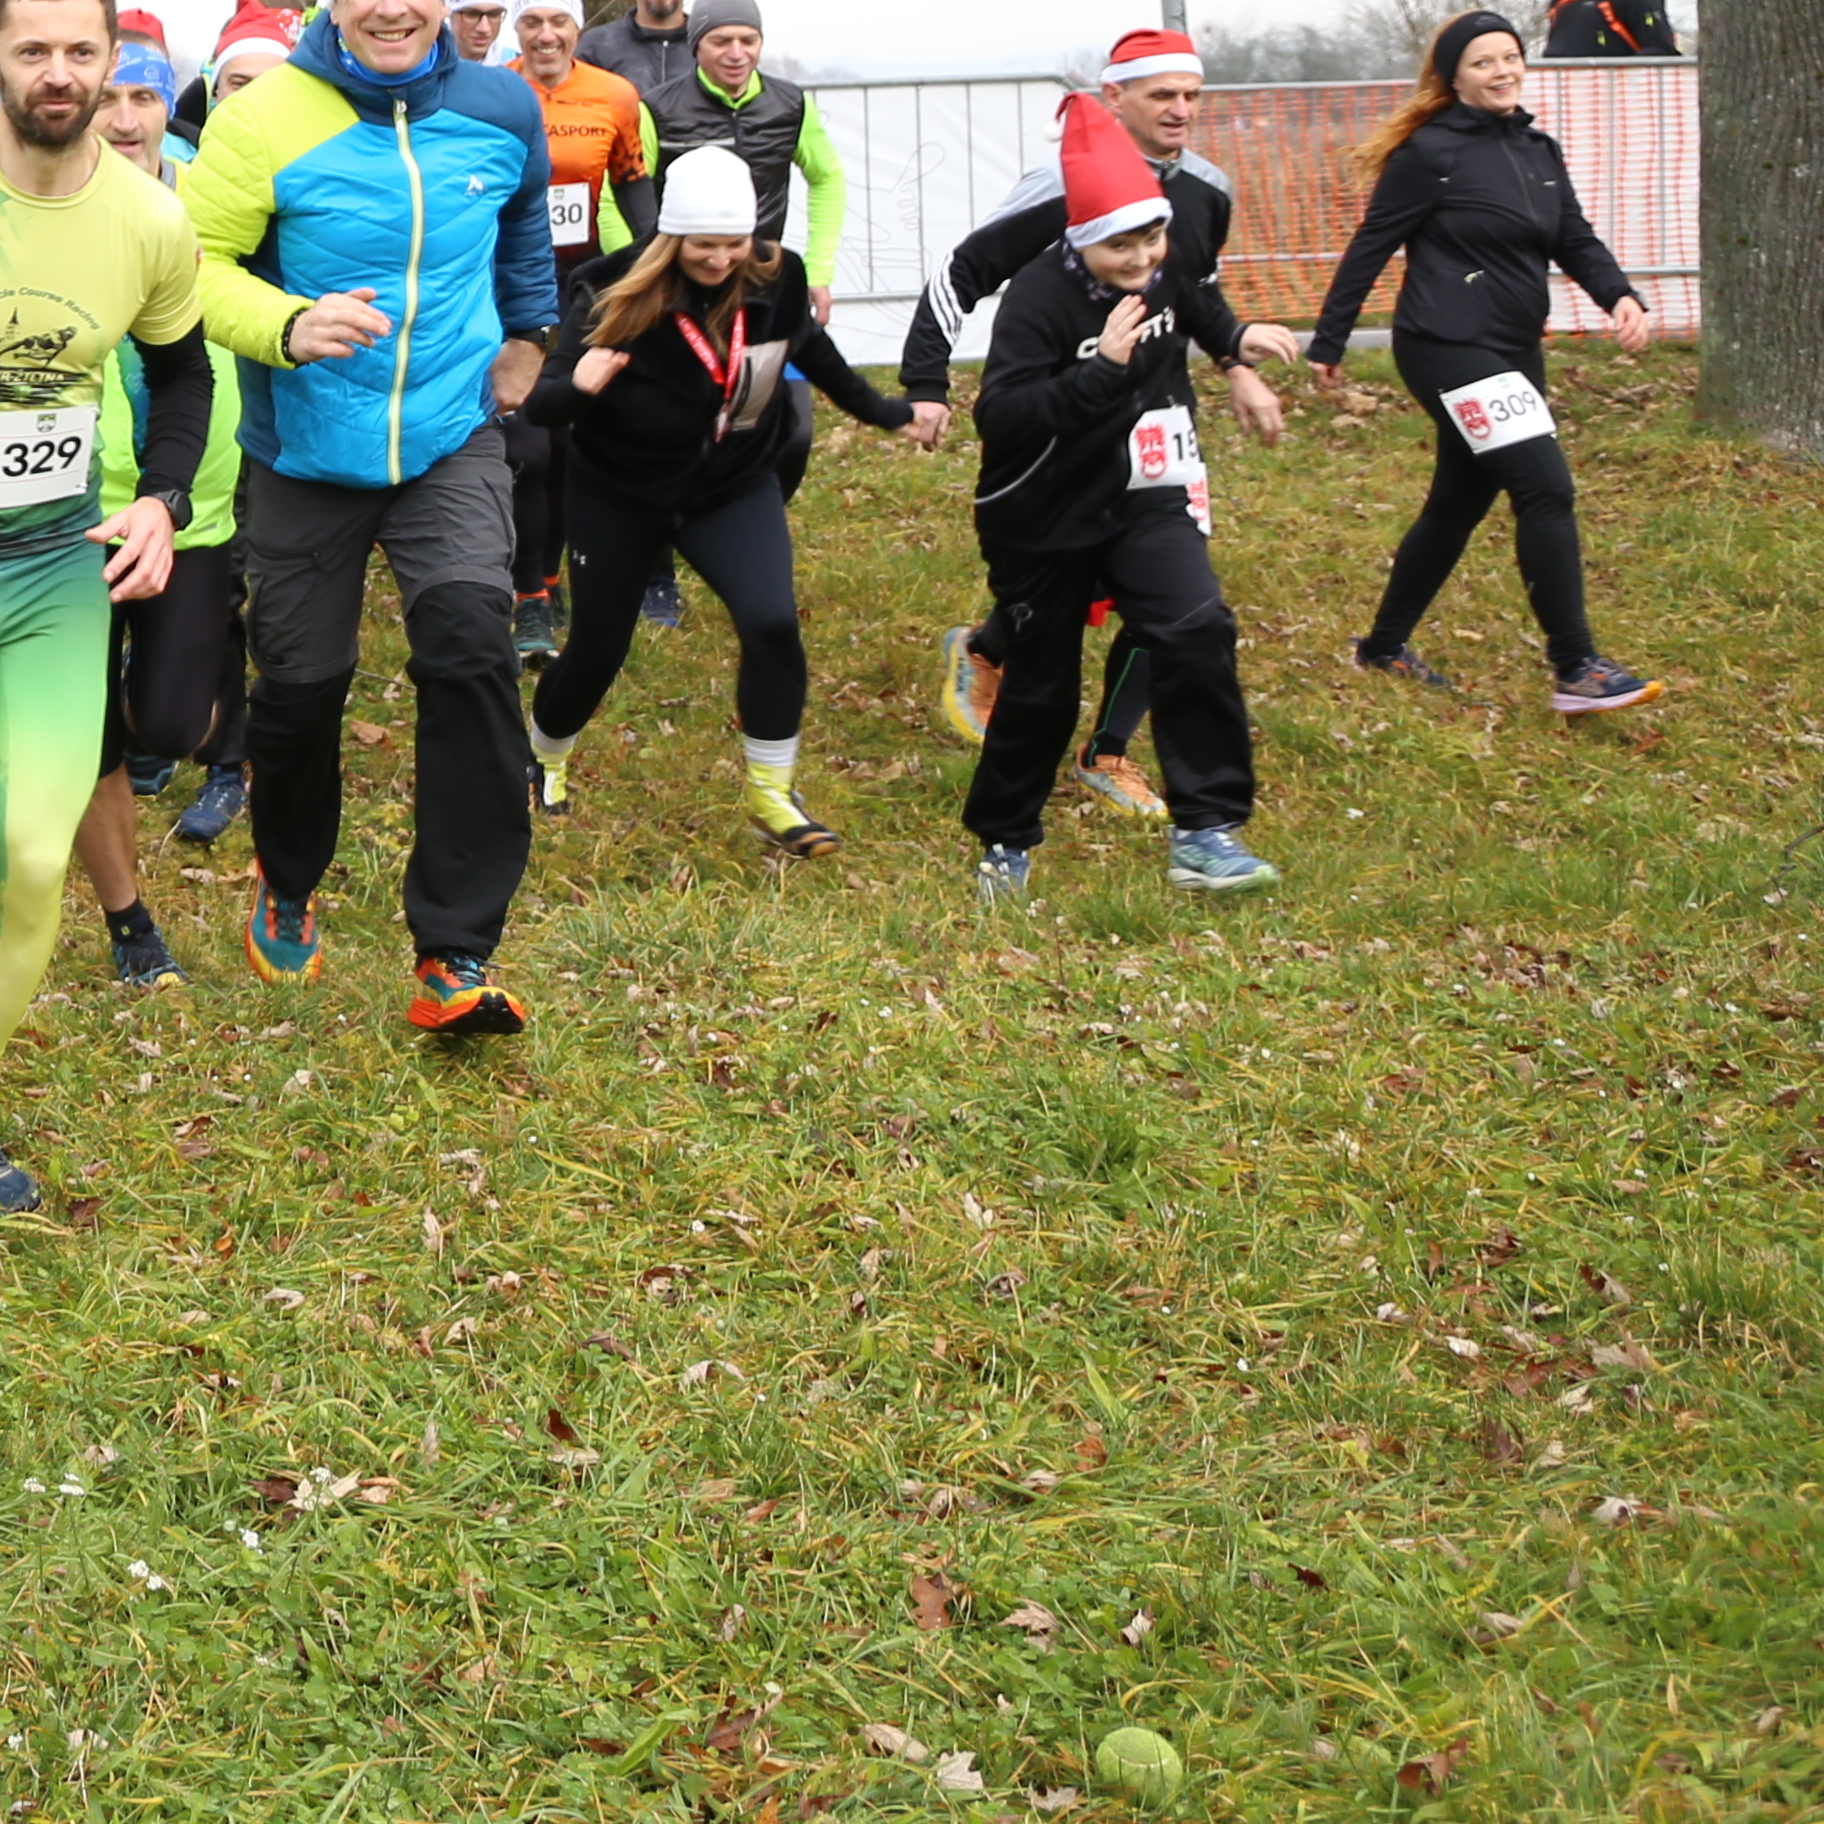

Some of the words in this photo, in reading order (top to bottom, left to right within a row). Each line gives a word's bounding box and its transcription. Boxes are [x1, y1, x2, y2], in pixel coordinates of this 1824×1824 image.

[18, 287, 64, 304] Course
[64, 299, 101, 331] Racing
[1489, 390, 1537, 423] 309
[2, 435, 83, 478] 329
